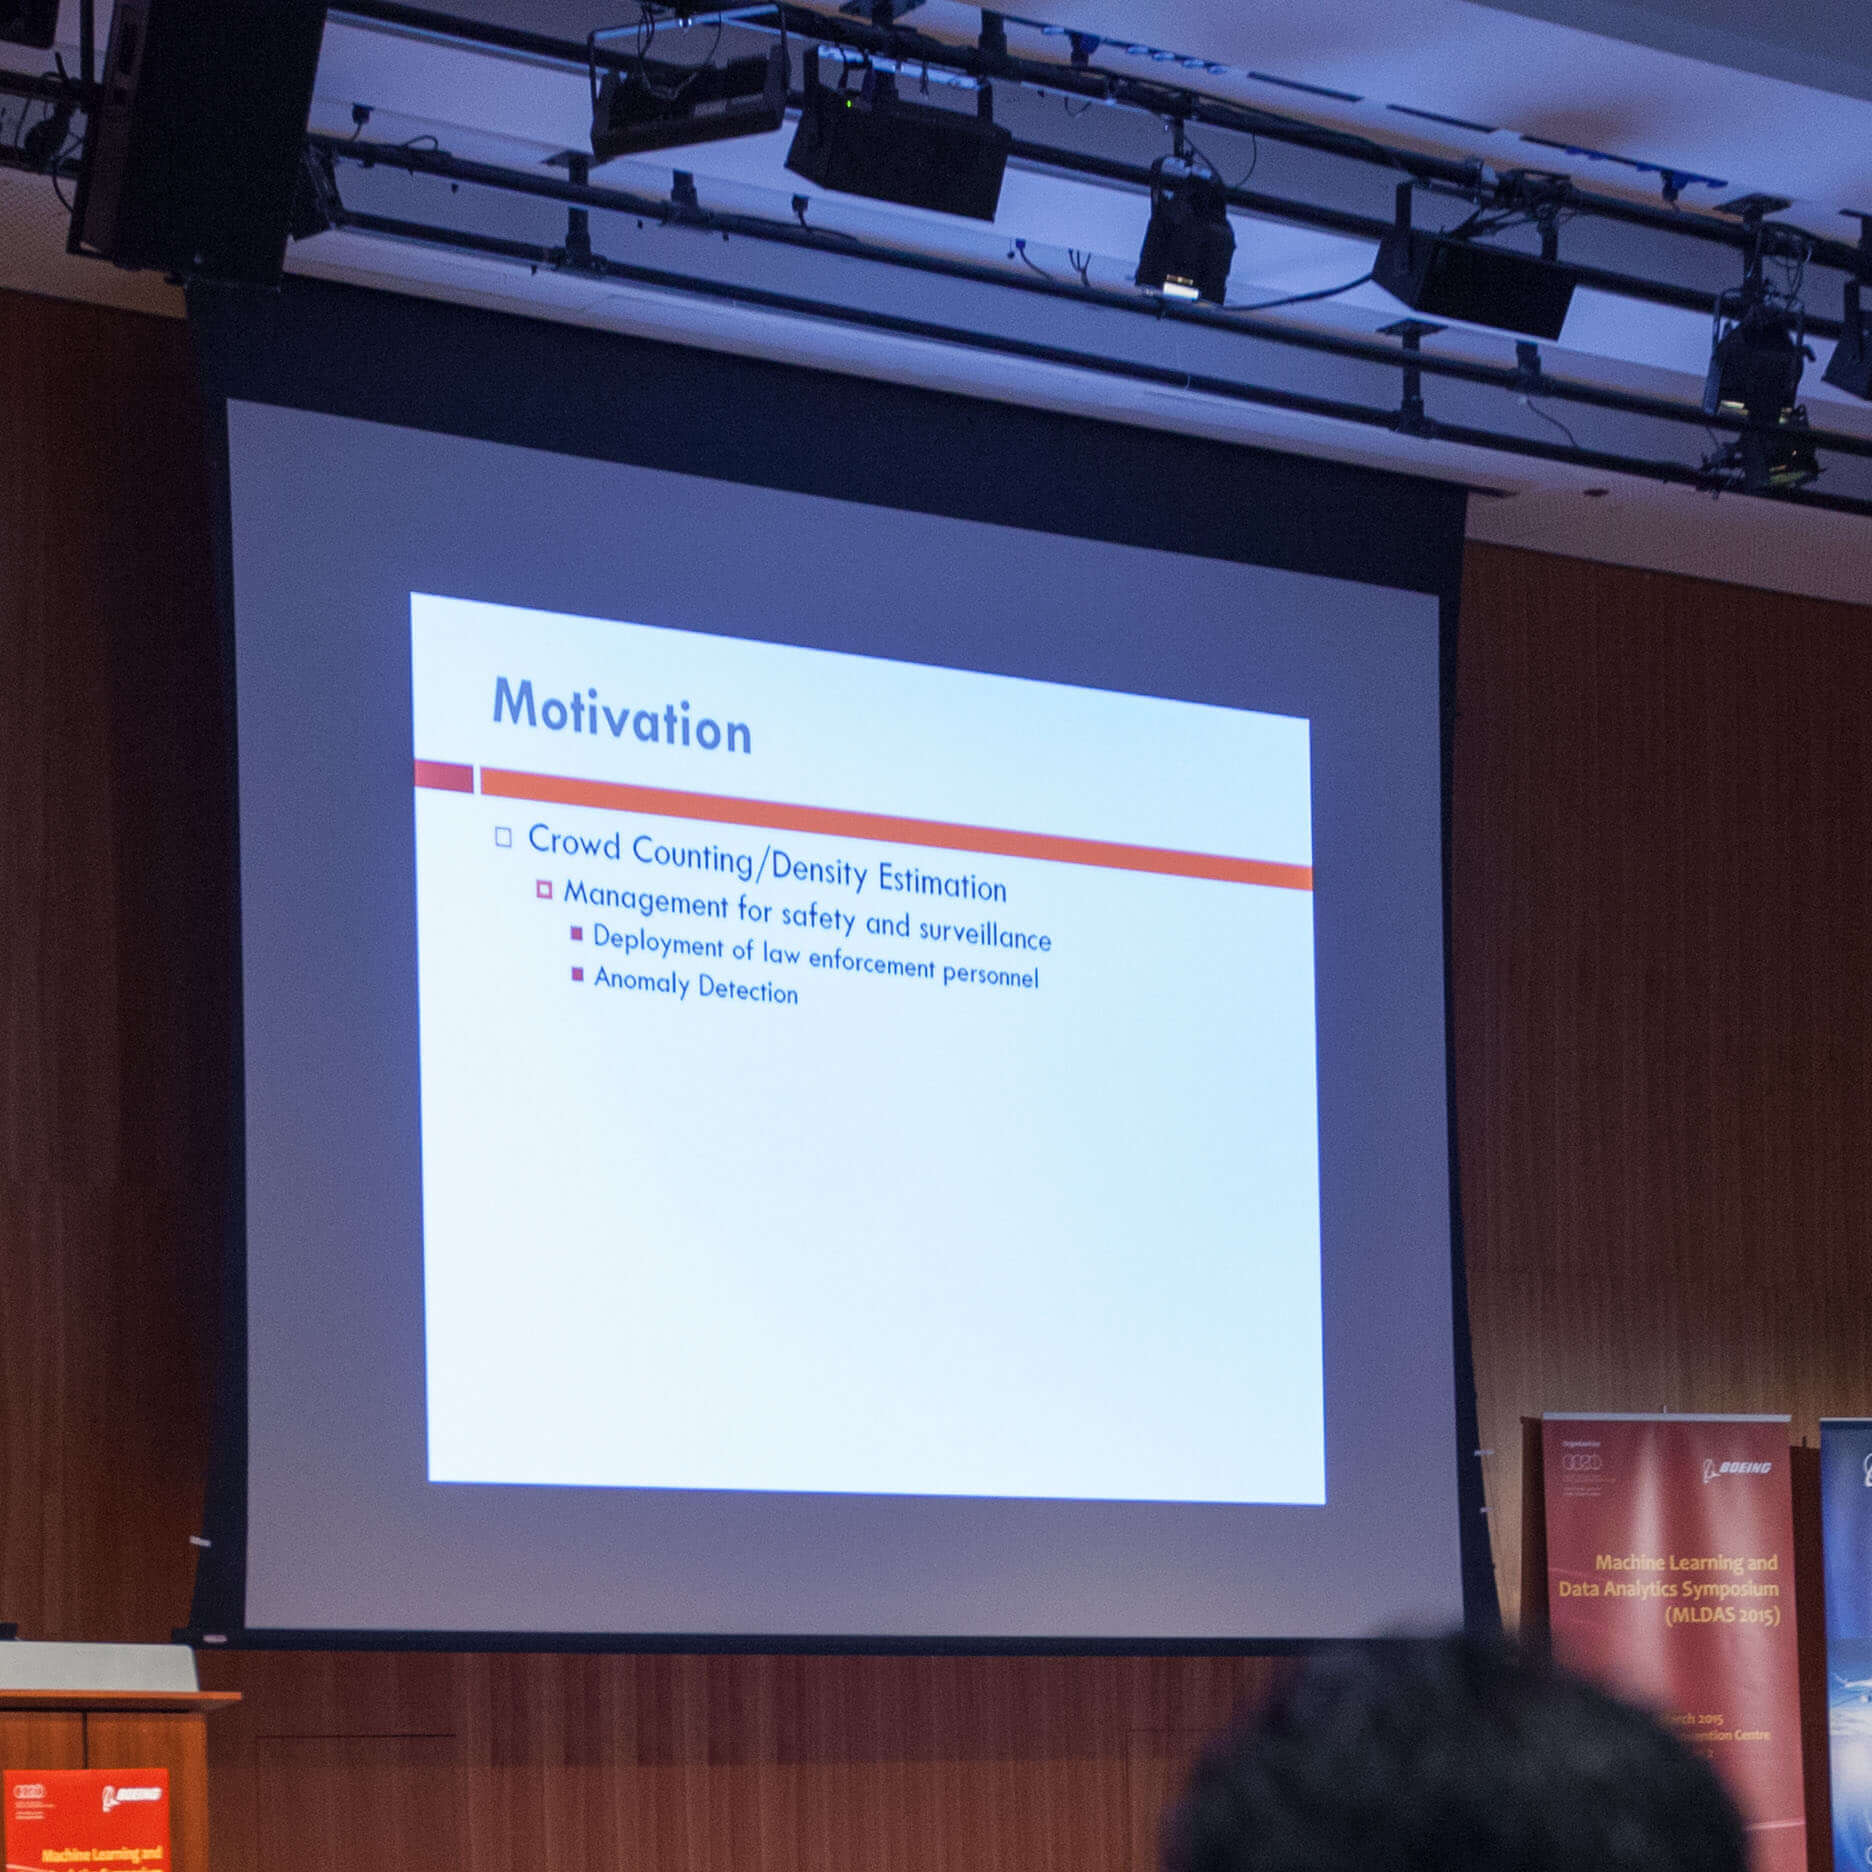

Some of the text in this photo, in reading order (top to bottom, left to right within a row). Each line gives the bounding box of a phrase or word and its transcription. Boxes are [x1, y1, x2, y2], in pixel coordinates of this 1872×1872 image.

[493, 676, 751, 754] Motivation
[528, 823, 1007, 903] Crowd Counting/Density Estimation
[564, 879, 1052, 951] Management for safety and surveillance
[594, 923, 1039, 989] Deployment of law enforcement personnel
[594, 966, 799, 1005] Anomaly Detection
[1719, 1461, 1772, 1474] BOEING
[1596, 1554, 1779, 1575] Machine Learning and
[1559, 1580, 1780, 1600] Data Analytics Symposium
[1665, 1605, 1782, 1628] (MLDAS 2015)
